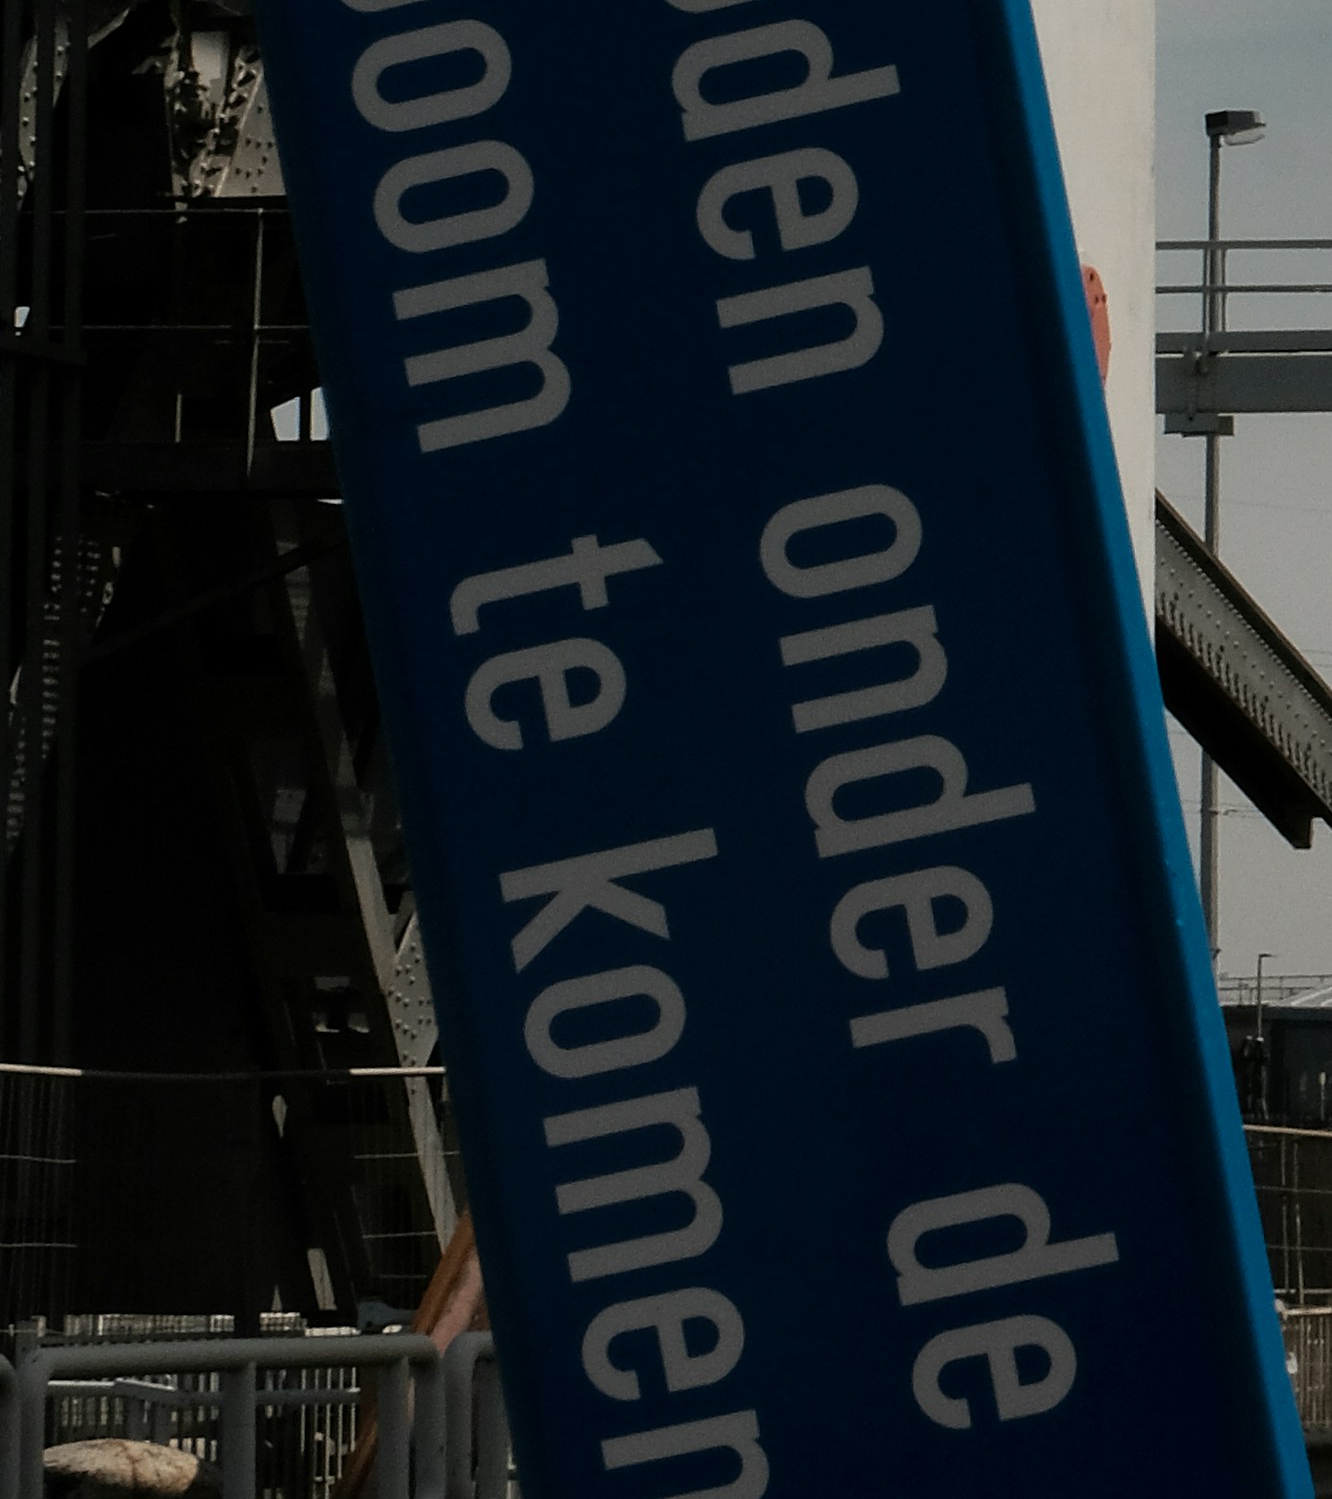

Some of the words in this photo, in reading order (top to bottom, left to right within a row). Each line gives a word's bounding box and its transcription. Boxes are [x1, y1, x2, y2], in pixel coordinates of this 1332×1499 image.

[449, 534, 662, 751] te
[759, 483, 1036, 1063] onder
[886, 1183, 1119, 1430] de
